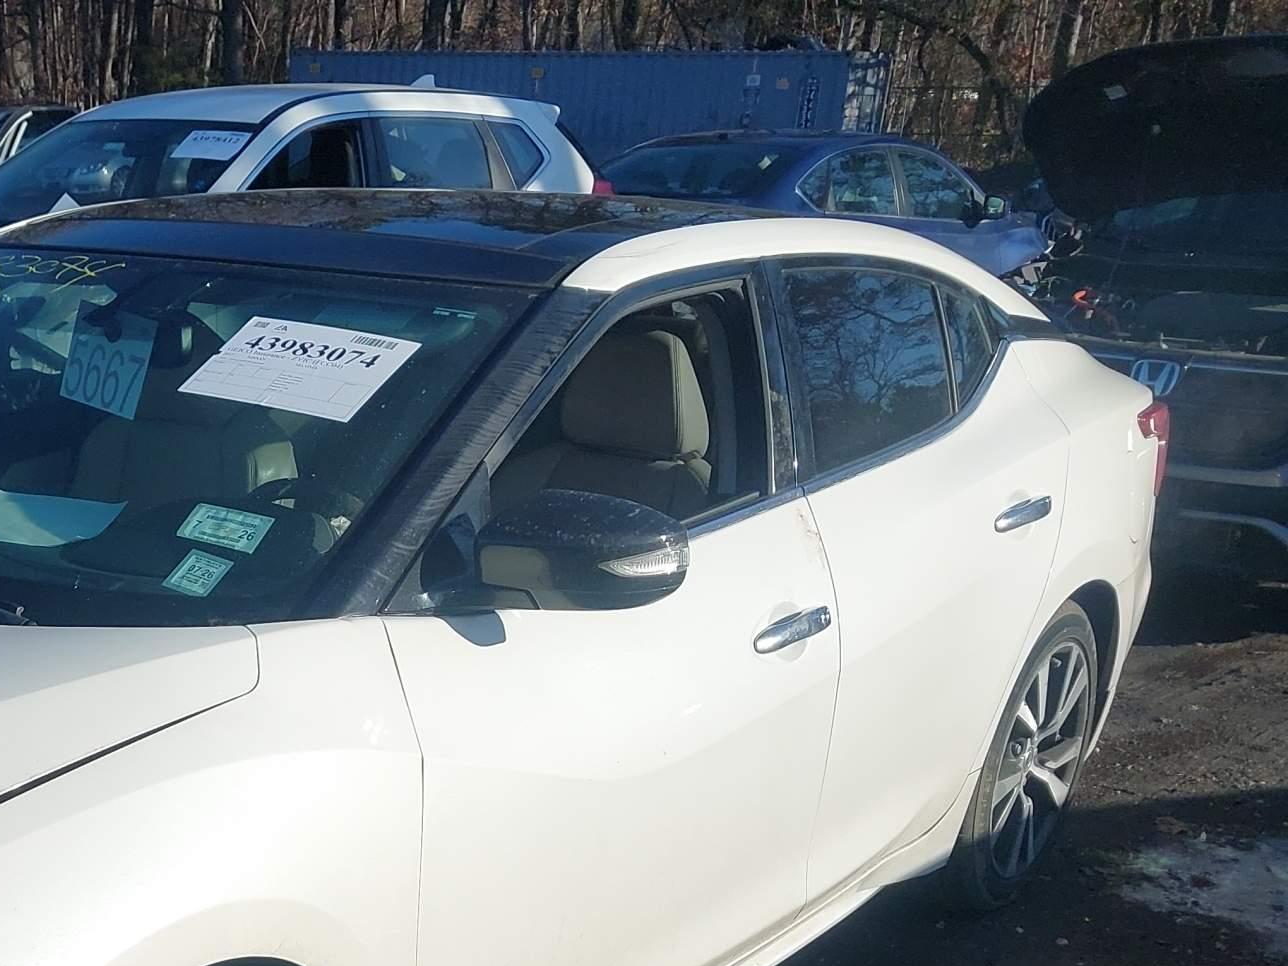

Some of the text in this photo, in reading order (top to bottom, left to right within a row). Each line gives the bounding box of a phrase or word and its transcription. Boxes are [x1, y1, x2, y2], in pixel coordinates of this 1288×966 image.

[245, 335, 382, 369] 43983074
[63, 335, 148, 413] 5667
[192, 520, 202, 528] 7
[238, 530, 256, 541] 26
